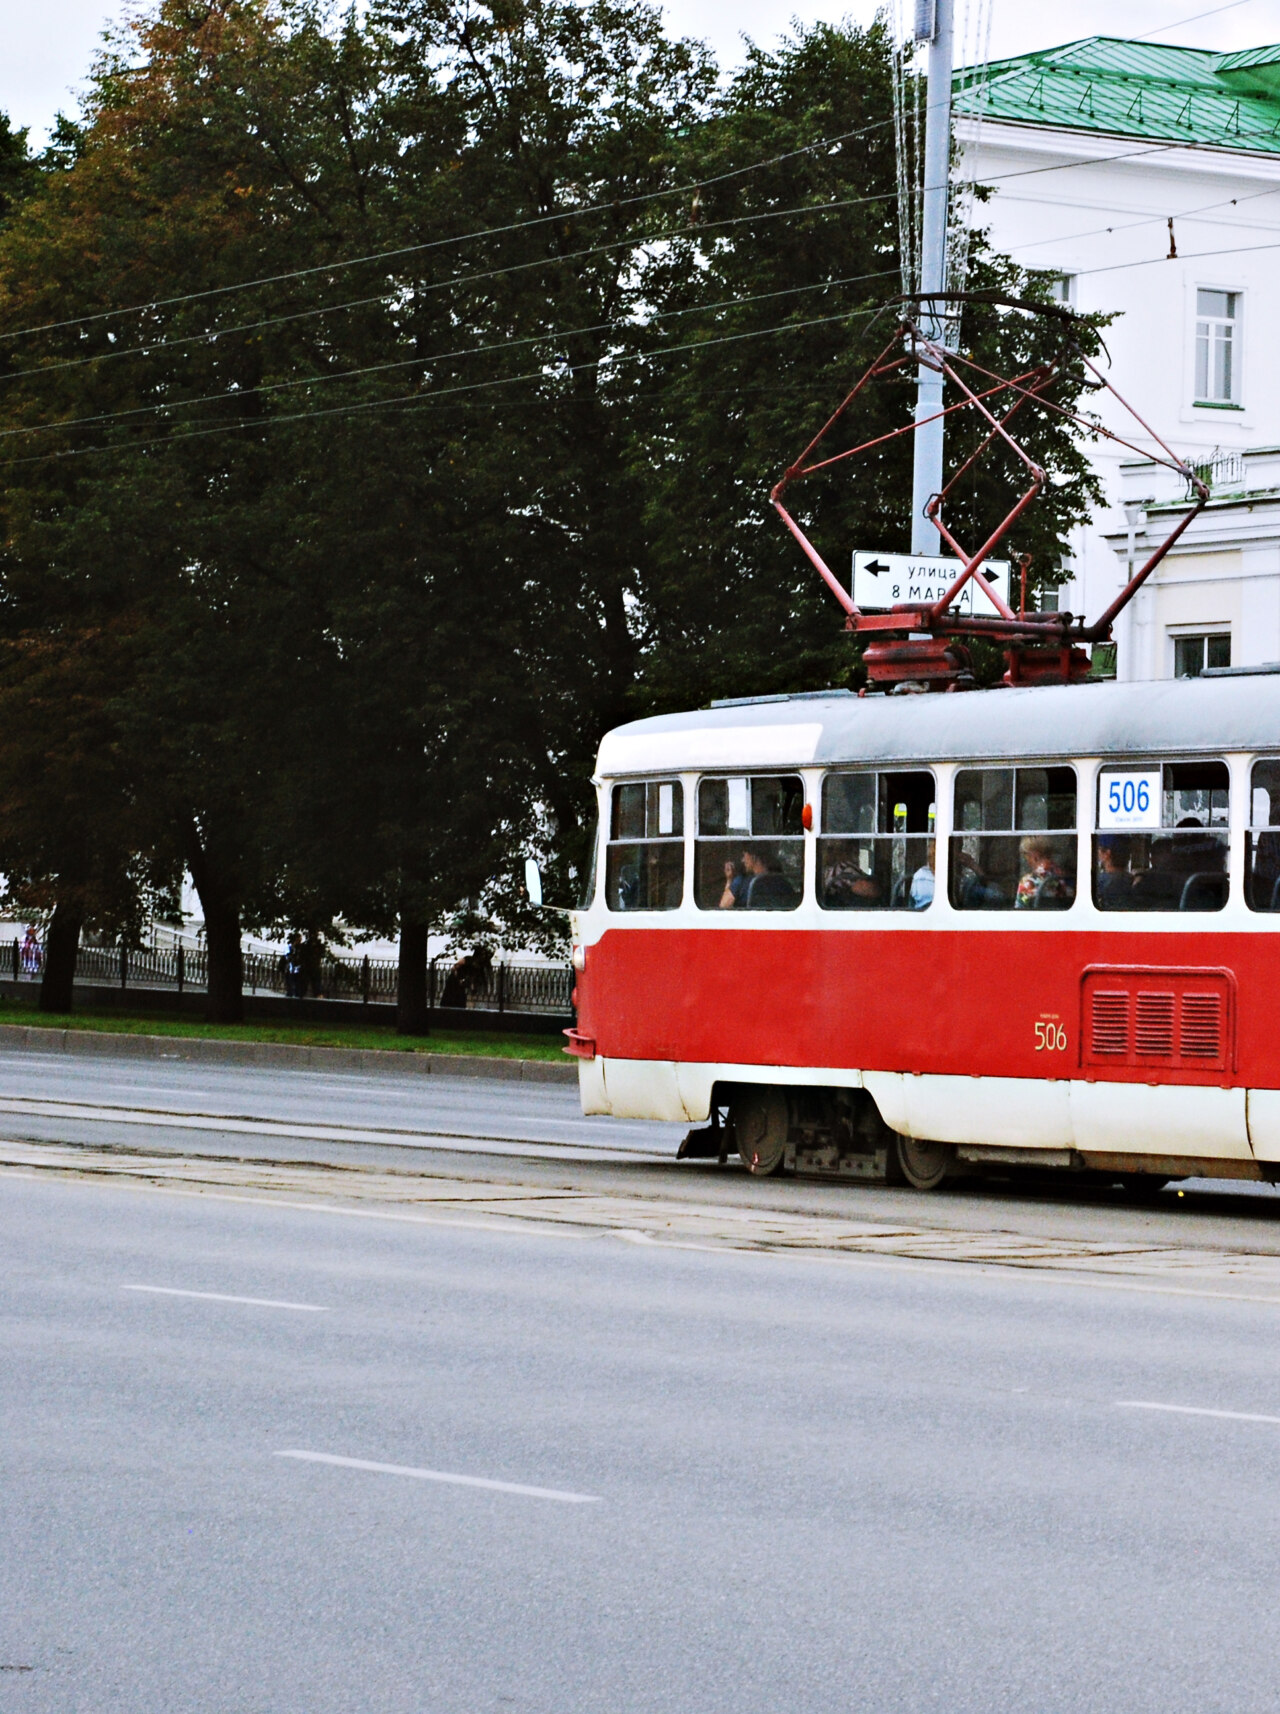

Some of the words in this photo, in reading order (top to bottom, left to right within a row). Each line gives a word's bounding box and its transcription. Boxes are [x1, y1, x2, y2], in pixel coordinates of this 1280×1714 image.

[907, 565, 957, 579] улица
[891, 584, 900, 598] 8
[908, 585, 970, 603] МАРА
[1108, 780, 1150, 813] 506
[1034, 1022, 1067, 1051] 506
